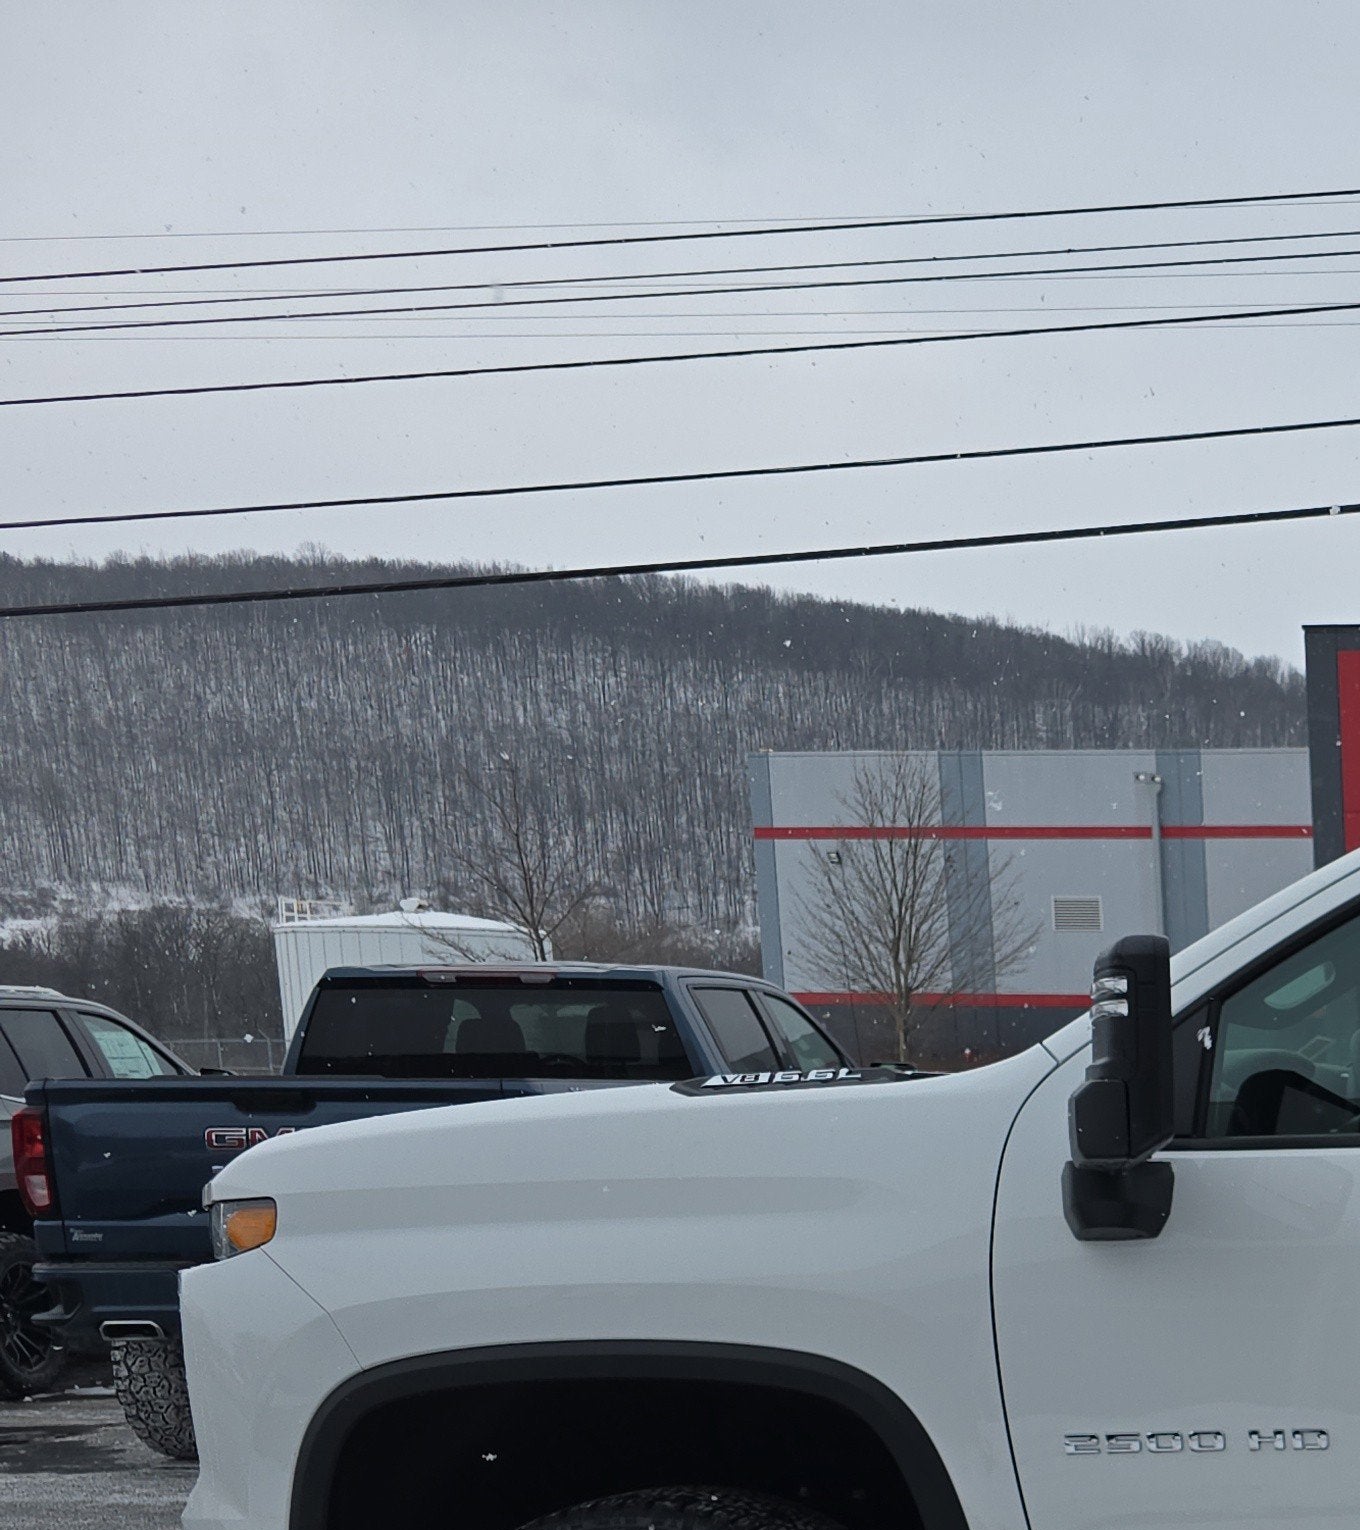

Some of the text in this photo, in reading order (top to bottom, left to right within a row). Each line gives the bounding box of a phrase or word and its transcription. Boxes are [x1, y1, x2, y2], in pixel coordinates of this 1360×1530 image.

[771, 1067, 862, 1083] 6.6L
[1063, 1429, 1330, 1455] 2500 HD
